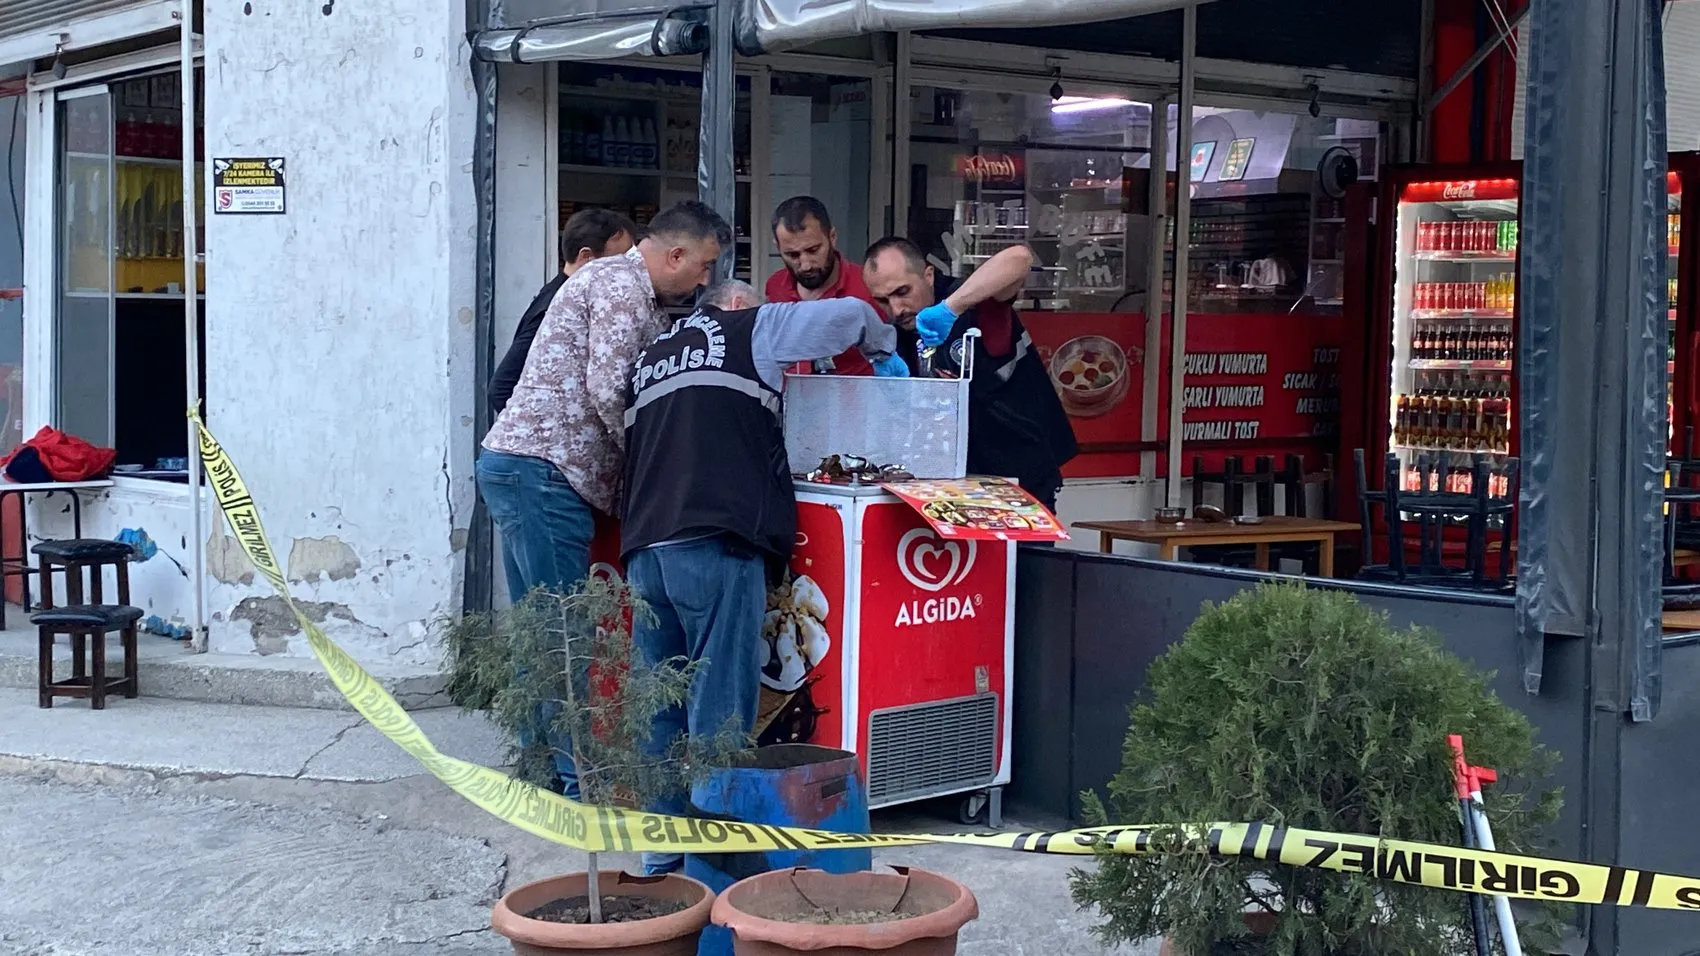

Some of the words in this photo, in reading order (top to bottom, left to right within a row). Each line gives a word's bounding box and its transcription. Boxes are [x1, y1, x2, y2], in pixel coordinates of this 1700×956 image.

[1218, 353, 1268, 376] YUMURTA
[1313, 348, 1341, 364] TOST
[1282, 373, 1318, 390] SICAK
[1215, 386, 1265, 408] YUMURTA
[1234, 421, 1260, 439] TOST
